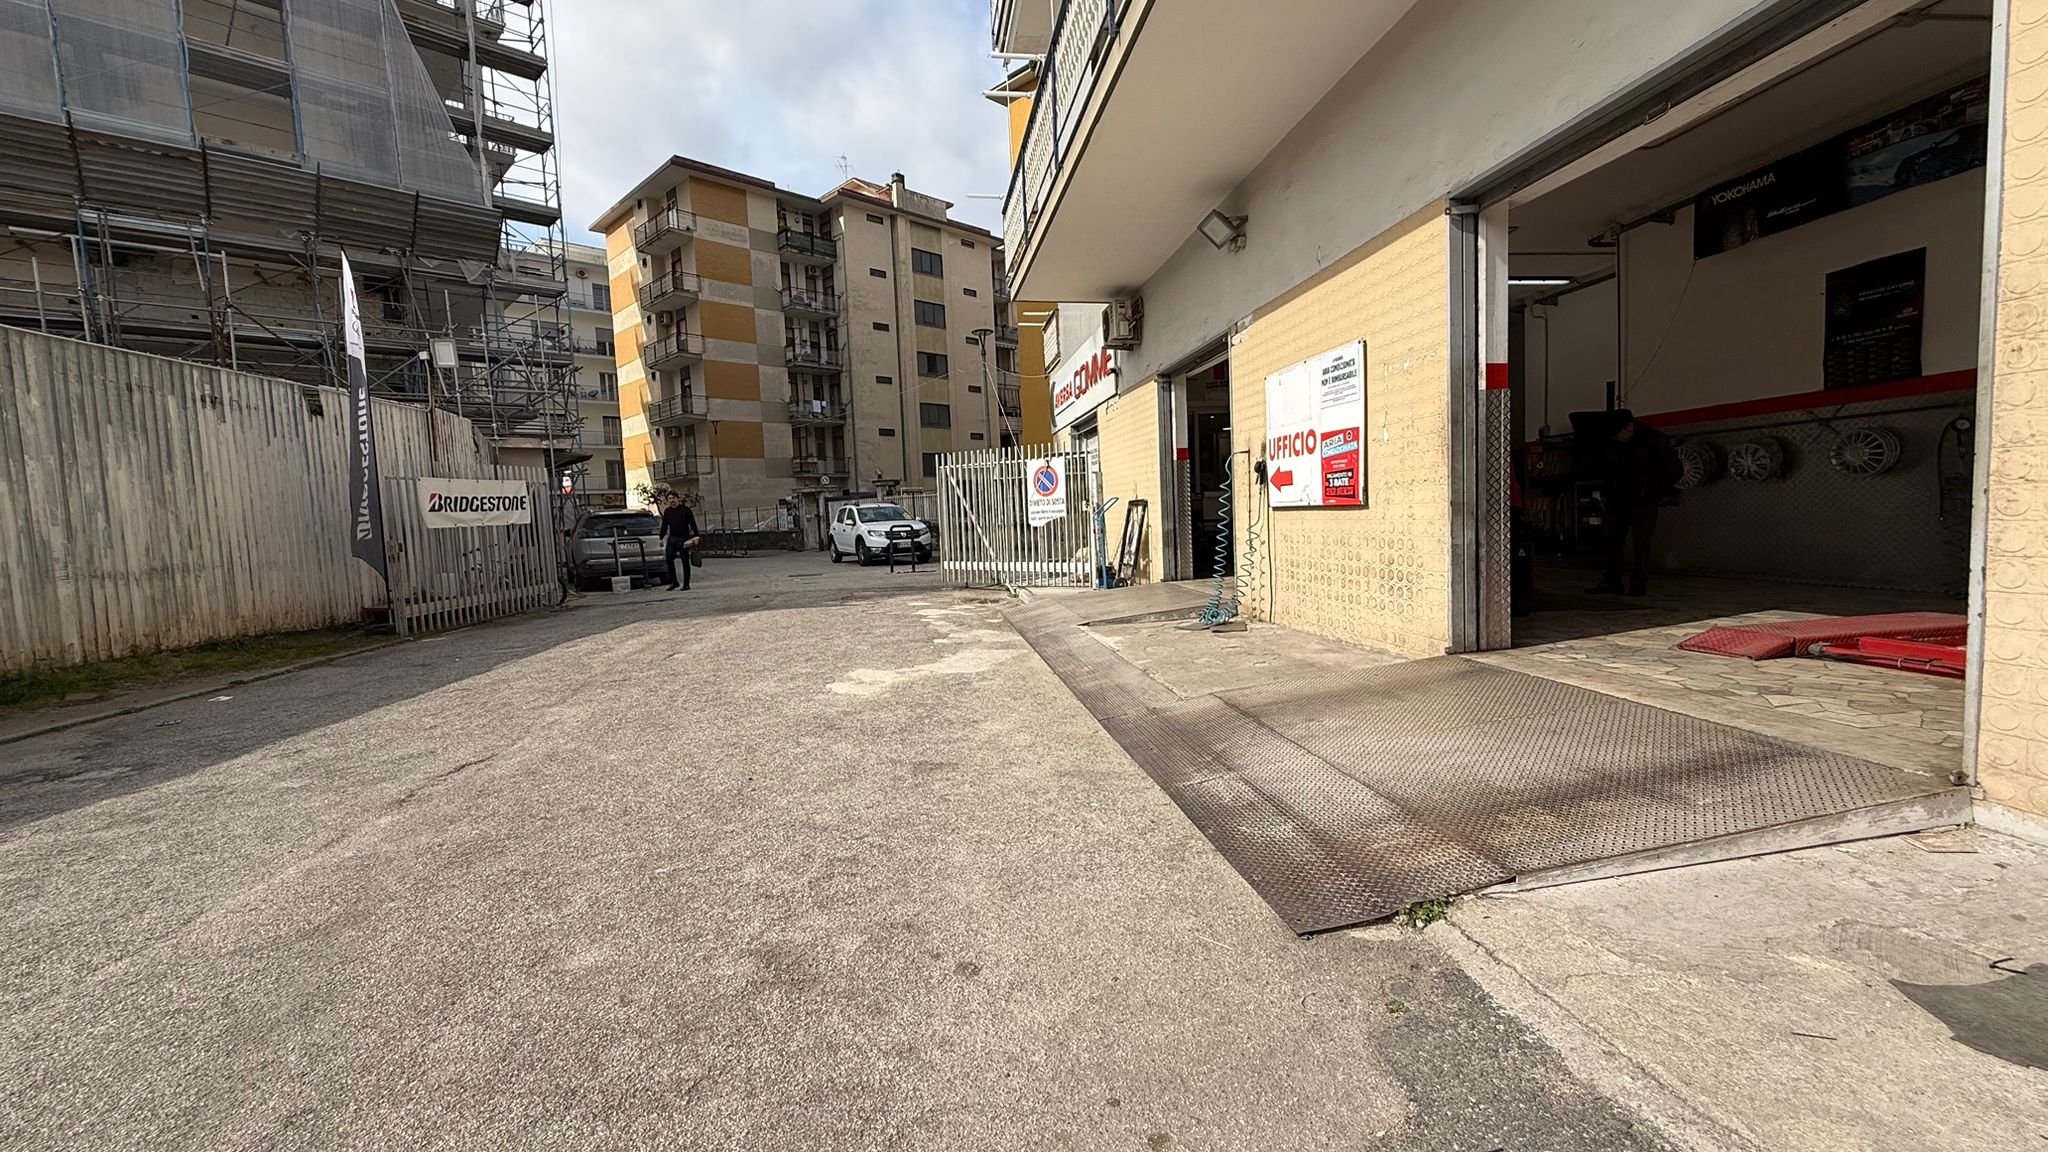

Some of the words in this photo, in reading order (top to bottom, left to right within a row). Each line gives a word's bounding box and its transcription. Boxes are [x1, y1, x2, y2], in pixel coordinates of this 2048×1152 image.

[1711, 172, 1776, 206] YOKOHAMA
[1055, 381, 1072, 409] AVERSA
[1074, 347, 1112, 400] GOMME
[1268, 428, 1317, 461] UFFICIO
[1323, 436, 1342, 449] ARIA
[1334, 477, 1350, 486] RATE
[428, 492, 527, 513] BRIDGESTONE
[1029, 498, 1045, 507] DIVIETO
[1052, 497, 1065, 506] SOSTA
